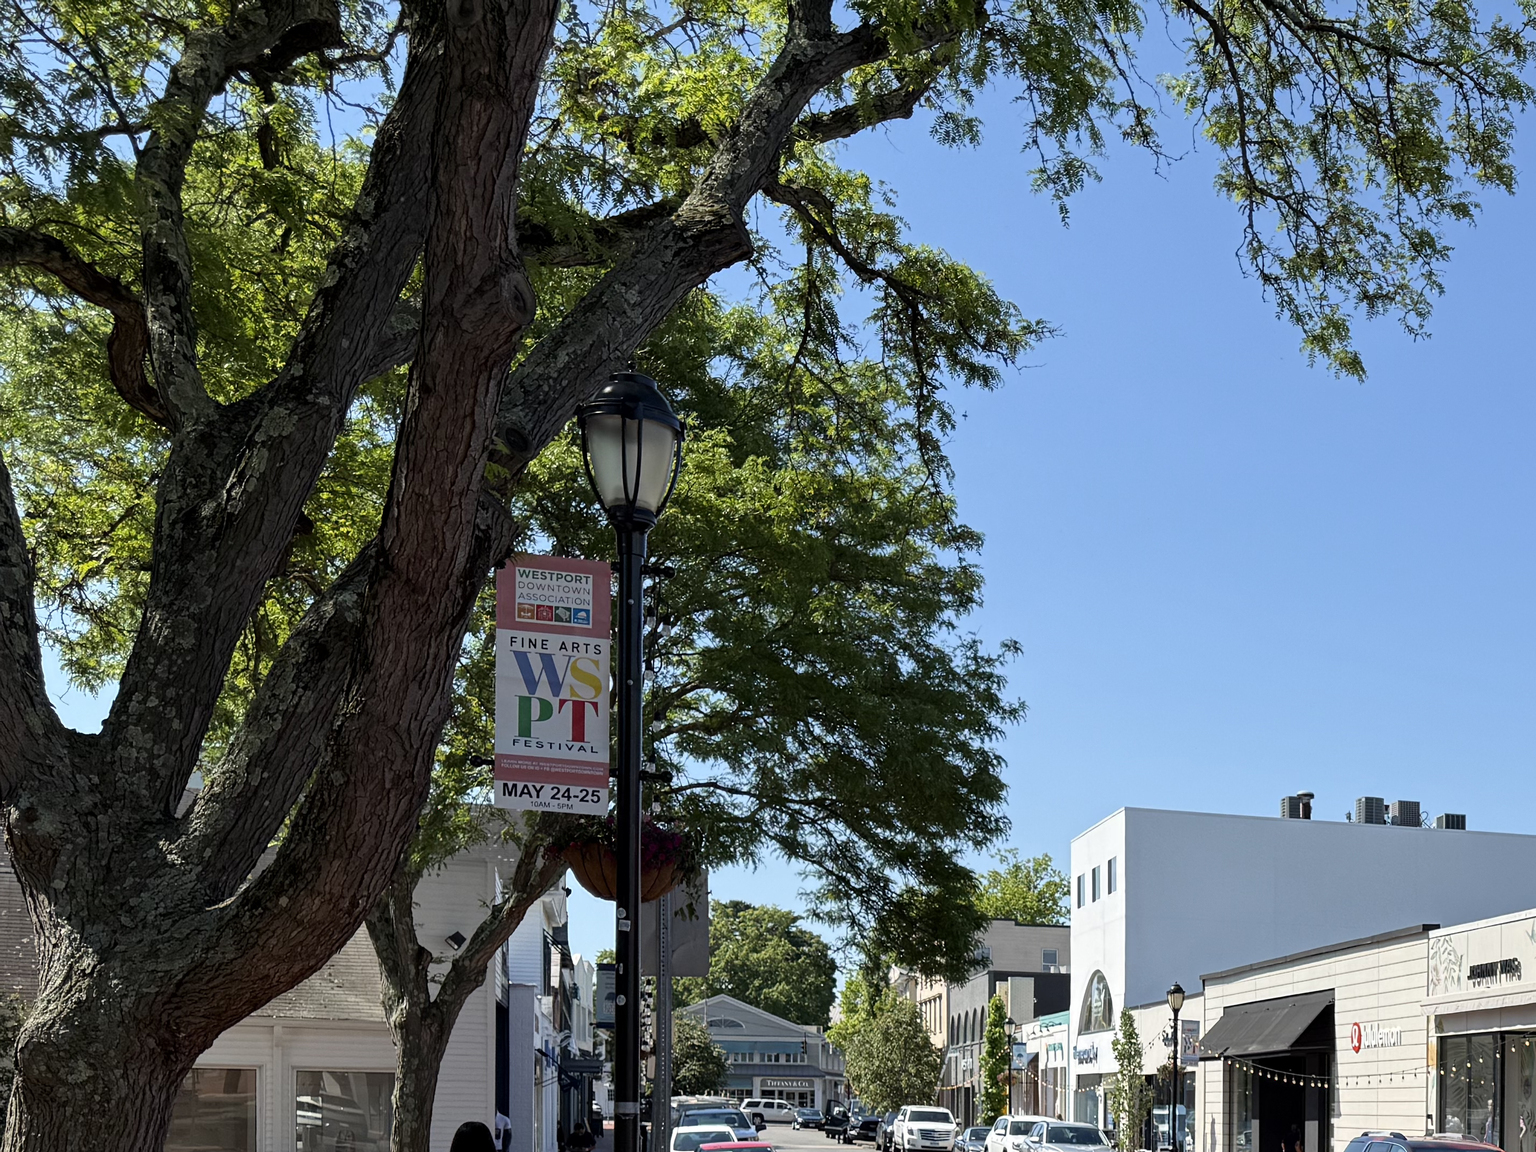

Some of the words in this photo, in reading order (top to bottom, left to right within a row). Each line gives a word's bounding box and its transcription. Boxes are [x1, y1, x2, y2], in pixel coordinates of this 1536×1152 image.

[518, 569, 591, 585] WESTPORT
[518, 581, 590, 595] DOWNTOWN
[518, 592, 590, 606] ASSOCIATION
[510, 636, 549, 650] FINE
[559, 641, 602, 655] ARTS
[512, 739, 599, 754] FESTIVAL
[502, 782, 545, 799] MAY
[550, 786, 600, 804] 24-25
[1362, 1022, 1401, 1049] lululemon
